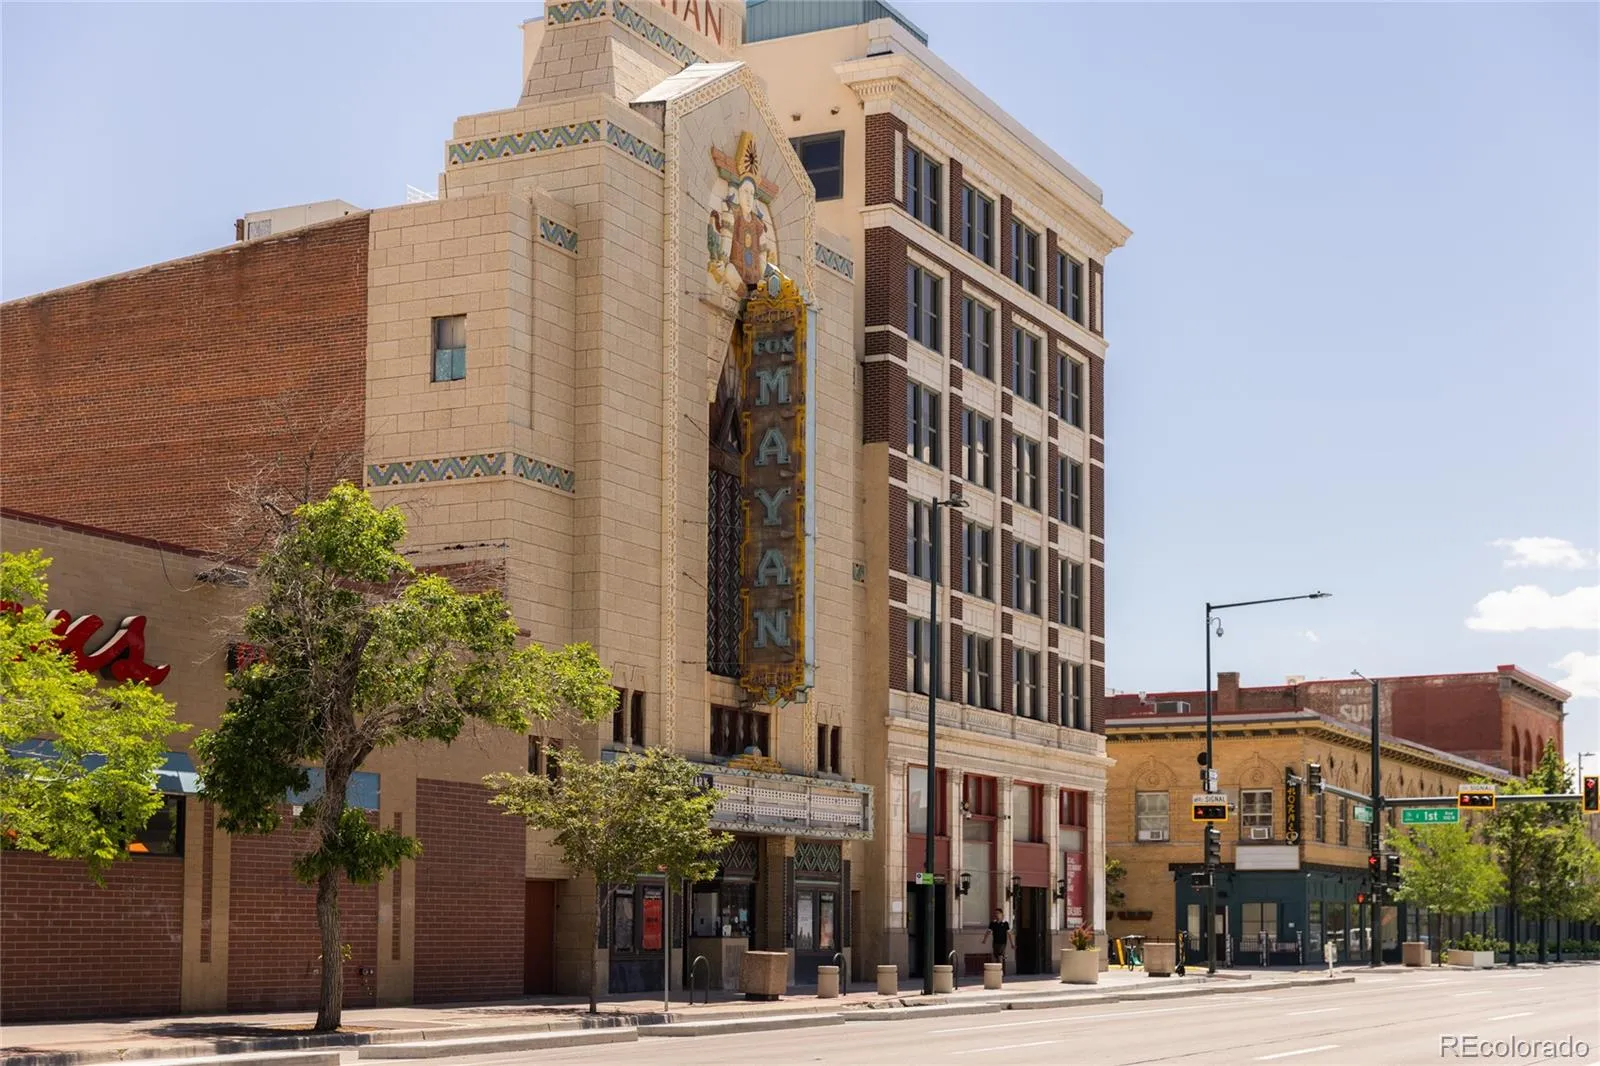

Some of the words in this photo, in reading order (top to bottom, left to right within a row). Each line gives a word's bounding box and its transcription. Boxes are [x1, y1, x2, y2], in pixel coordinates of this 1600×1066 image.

[661, 0, 722, 45] AN
[753, 335, 794, 355] FOX
[754, 365, 792, 649] MAYAN
[1424, 811, 1438, 821] 1st
